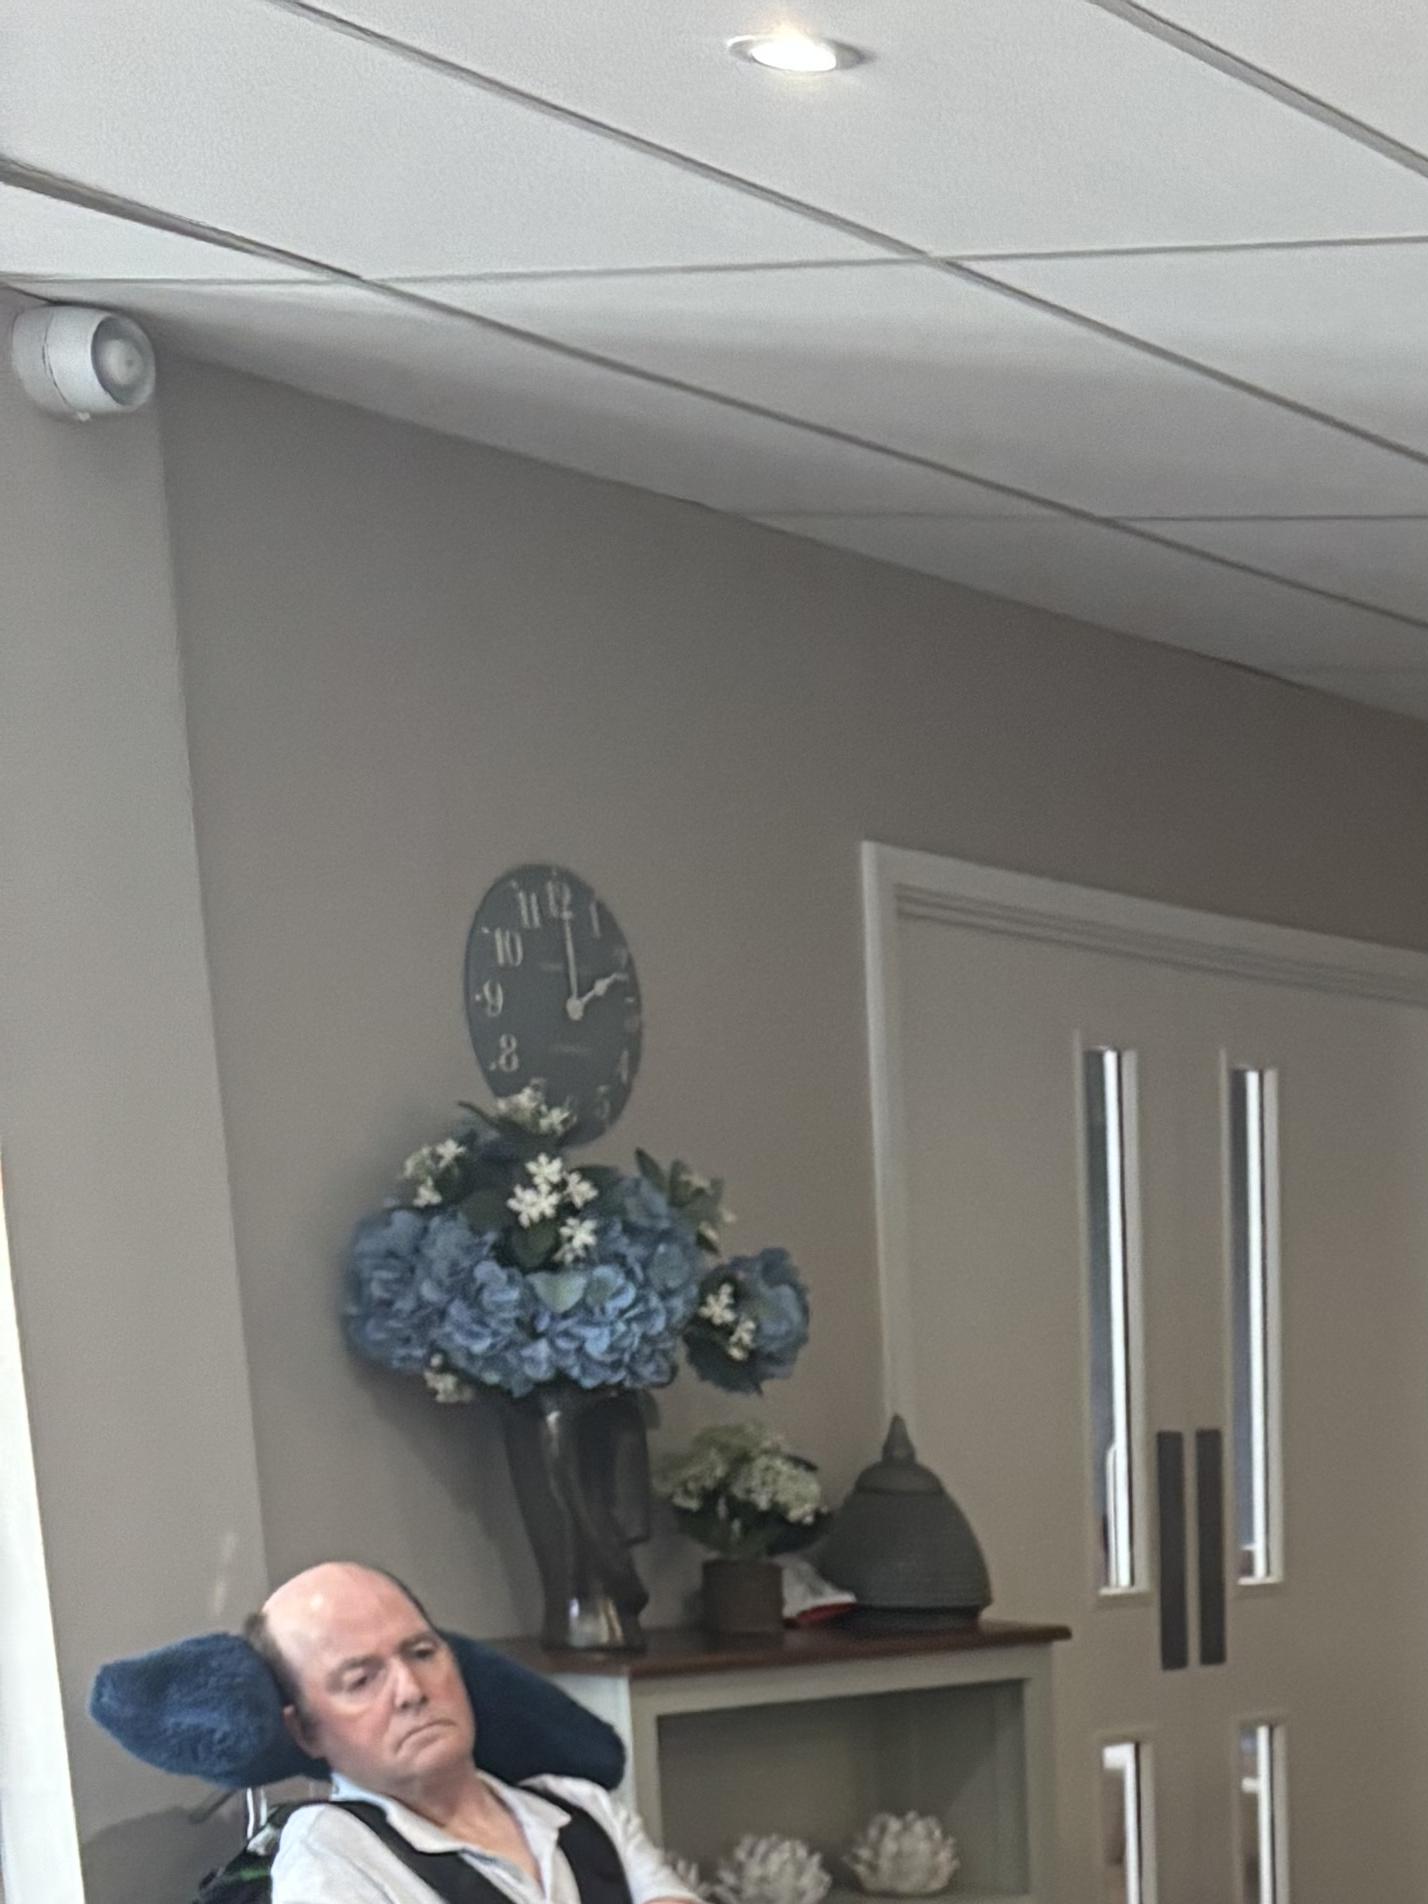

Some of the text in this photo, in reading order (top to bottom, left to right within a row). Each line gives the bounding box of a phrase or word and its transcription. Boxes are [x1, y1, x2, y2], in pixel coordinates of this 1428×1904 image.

[518, 889, 541, 929] 11
[588, 899, 602, 940] 1
[495, 927, 523, 968] 10
[483, 978, 504, 1018] 9
[498, 1033, 520, 1073] 8
